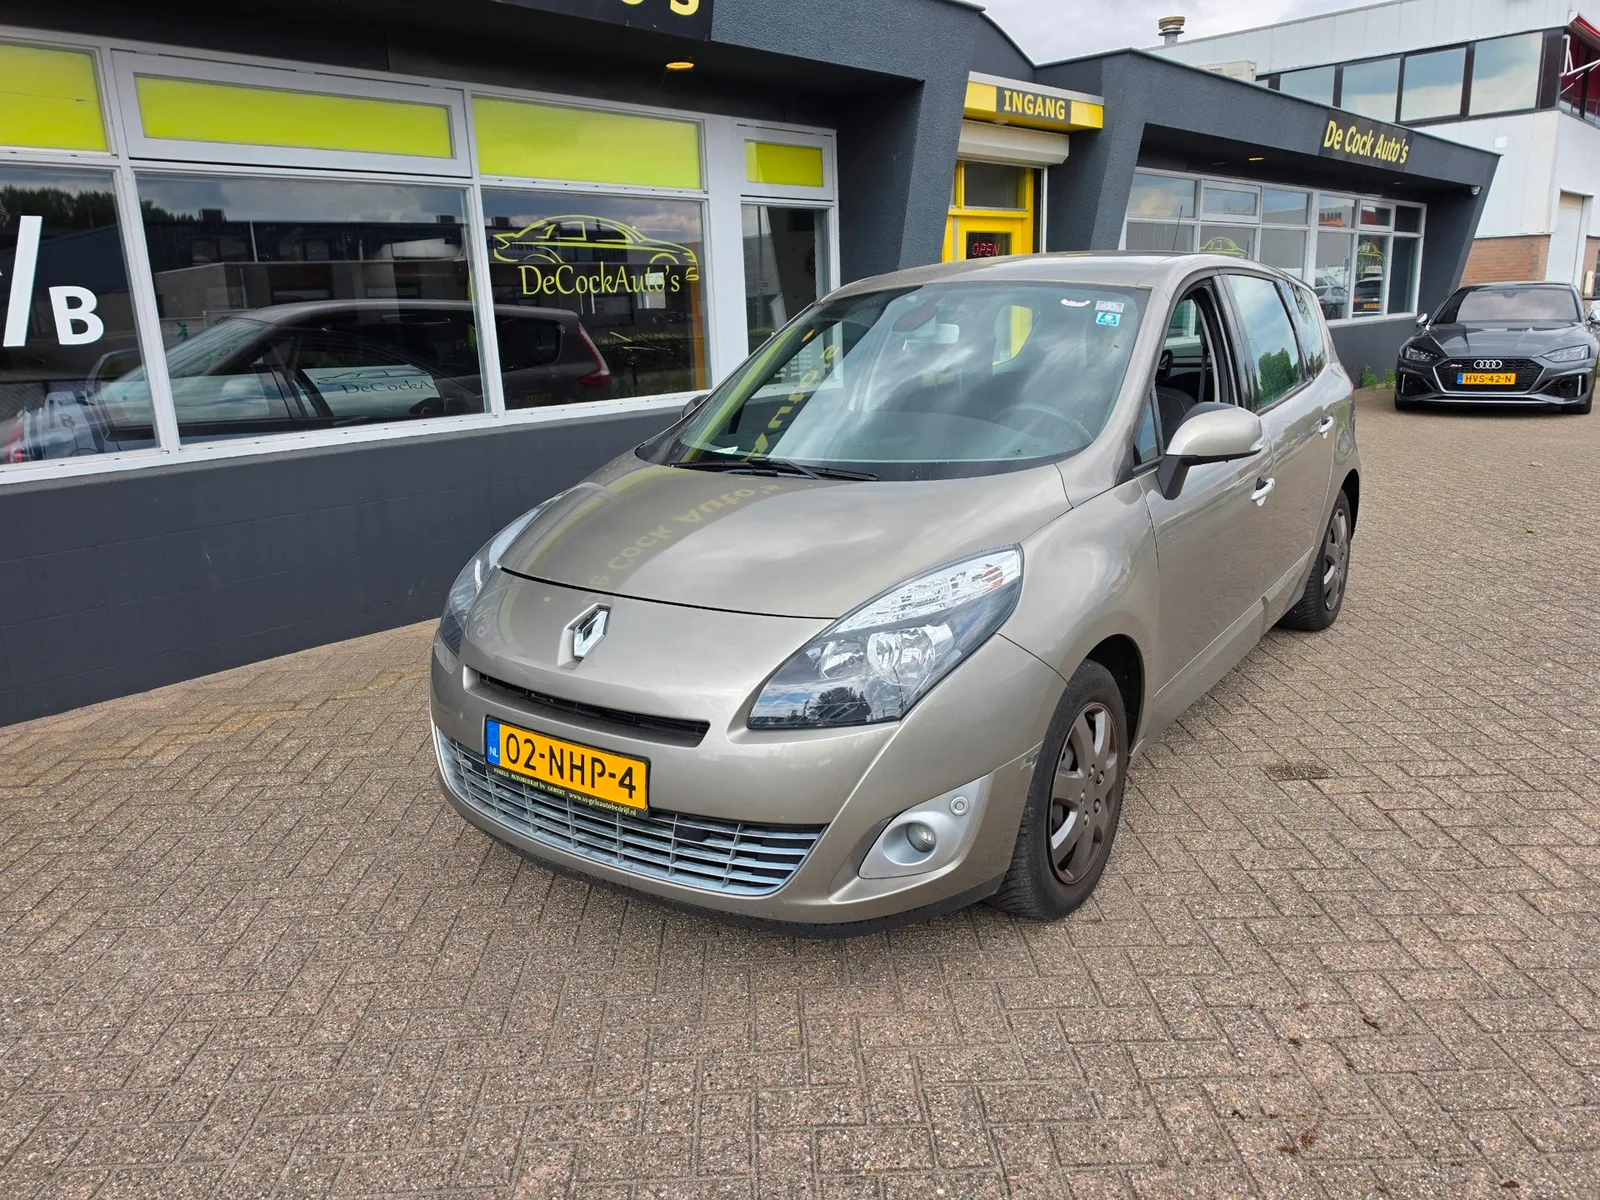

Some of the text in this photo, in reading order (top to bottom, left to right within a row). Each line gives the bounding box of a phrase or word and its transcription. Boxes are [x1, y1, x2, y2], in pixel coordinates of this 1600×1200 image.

[1003, 90, 1066, 120] INGANG
[1323, 120, 1409, 164] De Cock Auto's
[972, 241, 1001, 256] OPEN
[0, 215, 104, 346] /B
[517, 261, 680, 295] DeCockAuto's
[1465, 374, 1512, 383] HVS-42-N
[489, 746, 500, 758] NL
[506, 733, 637, 799] 02-NHP-4
